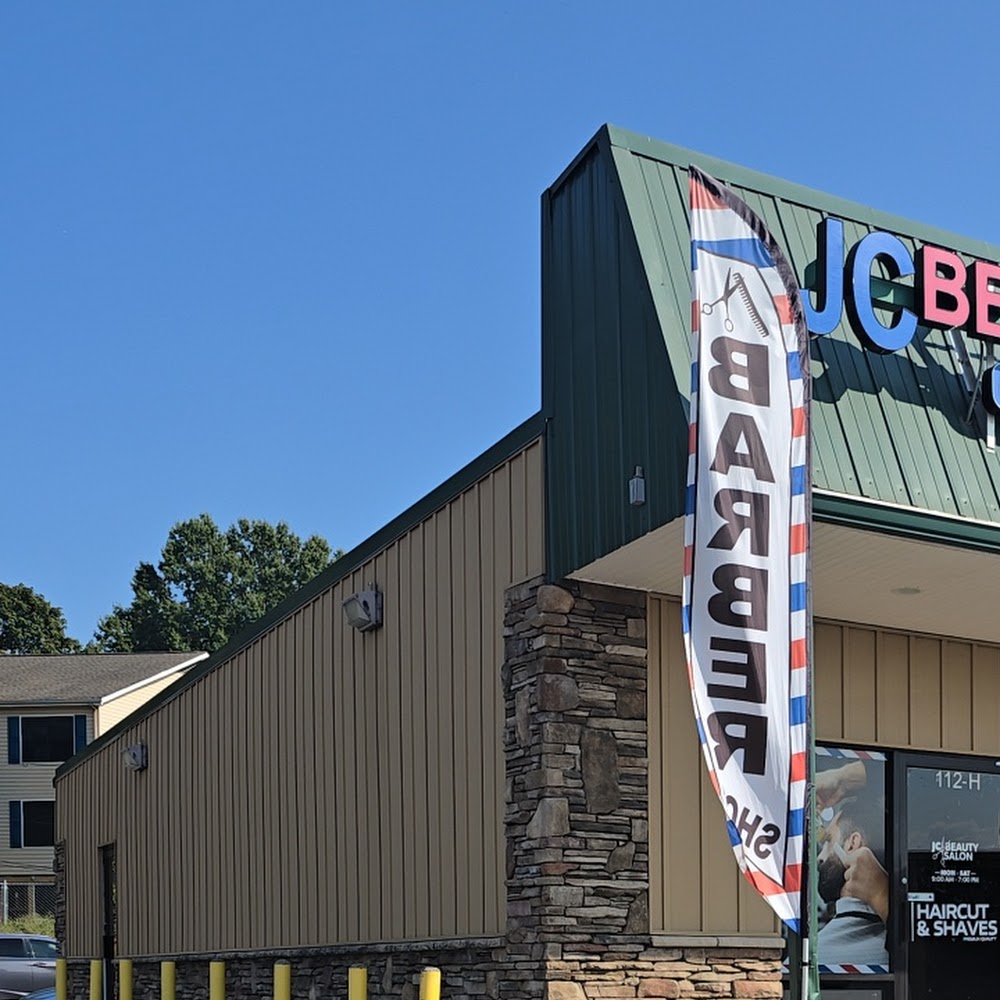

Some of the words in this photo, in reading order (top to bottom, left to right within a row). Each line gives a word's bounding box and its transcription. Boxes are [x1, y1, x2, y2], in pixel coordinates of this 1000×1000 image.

[801, 217, 918, 352] JC
[936, 769, 981, 791] 112-H
[931, 841, 941, 853] JC
[944, 841, 979, 853] BEAUTY
[943, 852, 974, 861] SALON
[916, 903, 990, 920] HAIRCUT
[916, 920, 931, 937] &
[933, 920, 998, 937] SHAVES
